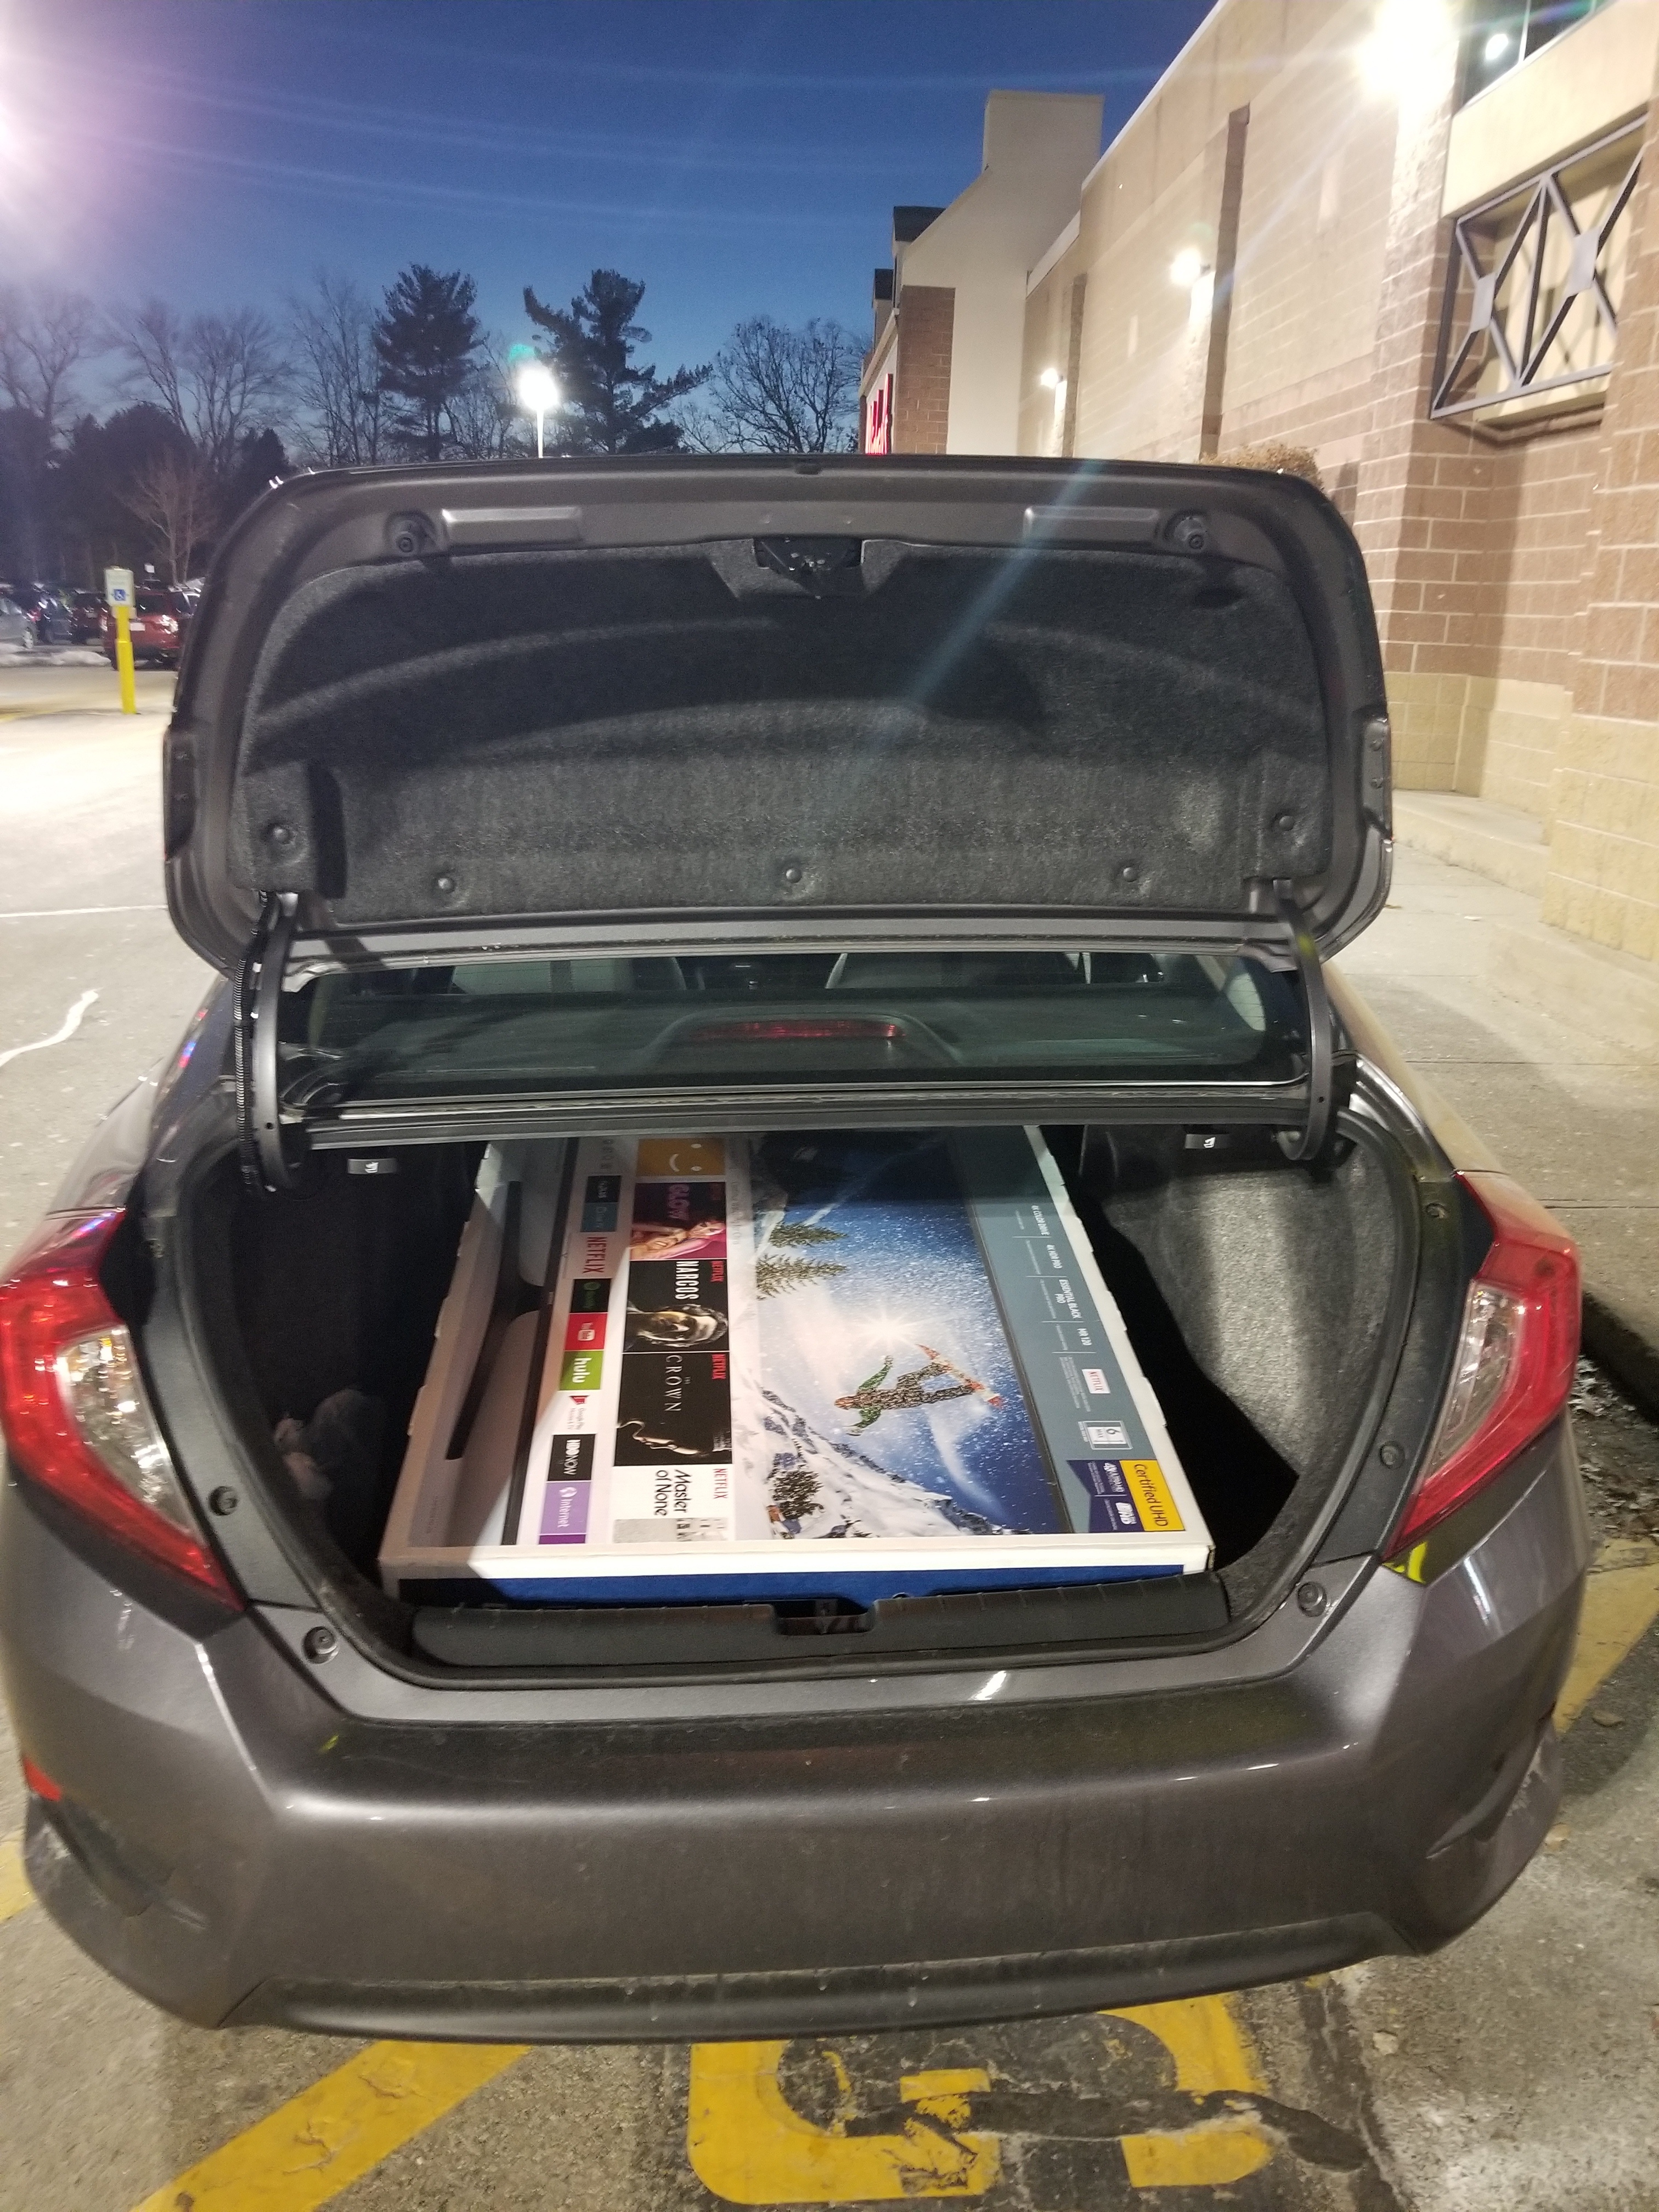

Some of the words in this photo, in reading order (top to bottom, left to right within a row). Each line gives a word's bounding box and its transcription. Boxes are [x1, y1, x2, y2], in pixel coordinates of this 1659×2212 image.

[668, 1184, 690, 1220] GLOW
[1034, 1211, 1046, 1223] COLOR
[1037, 1223, 1050, 1235] DRIVE
[582, 1237, 607, 1274] NETFLIX
[1048, 1250, 1060, 1259] HDR
[1052, 1259, 1063, 1268] PRO
[675, 1261, 700, 1300] NARCOS
[710, 1261, 724, 1282] NETFLIX
[1054, 1294, 1065, 1304] PRO
[1059, 1279, 1075, 1302] ESSENTIAL
[1068, 1303, 1082, 1319] BLACK
[1077, 1328, 1088, 1336] MR
[1080, 1336, 1092, 1346] 120
[572, 1358, 591, 1384] hulu
[710, 1354, 726, 1380] NETFLIX
[663, 1355, 684, 1412] CROWN
[1088, 1371, 1103, 1391] NETFLIX
[655, 1470, 671, 1481] of
[713, 1468, 729, 1499] NETFLIX
[653, 1485, 672, 1516] None
[673, 1469, 693, 1513] Master
[1134, 1464, 1159, 1504] Certified
[1149, 1505, 1169, 1527] UHD
[556, 1499, 573, 1528] Internet
